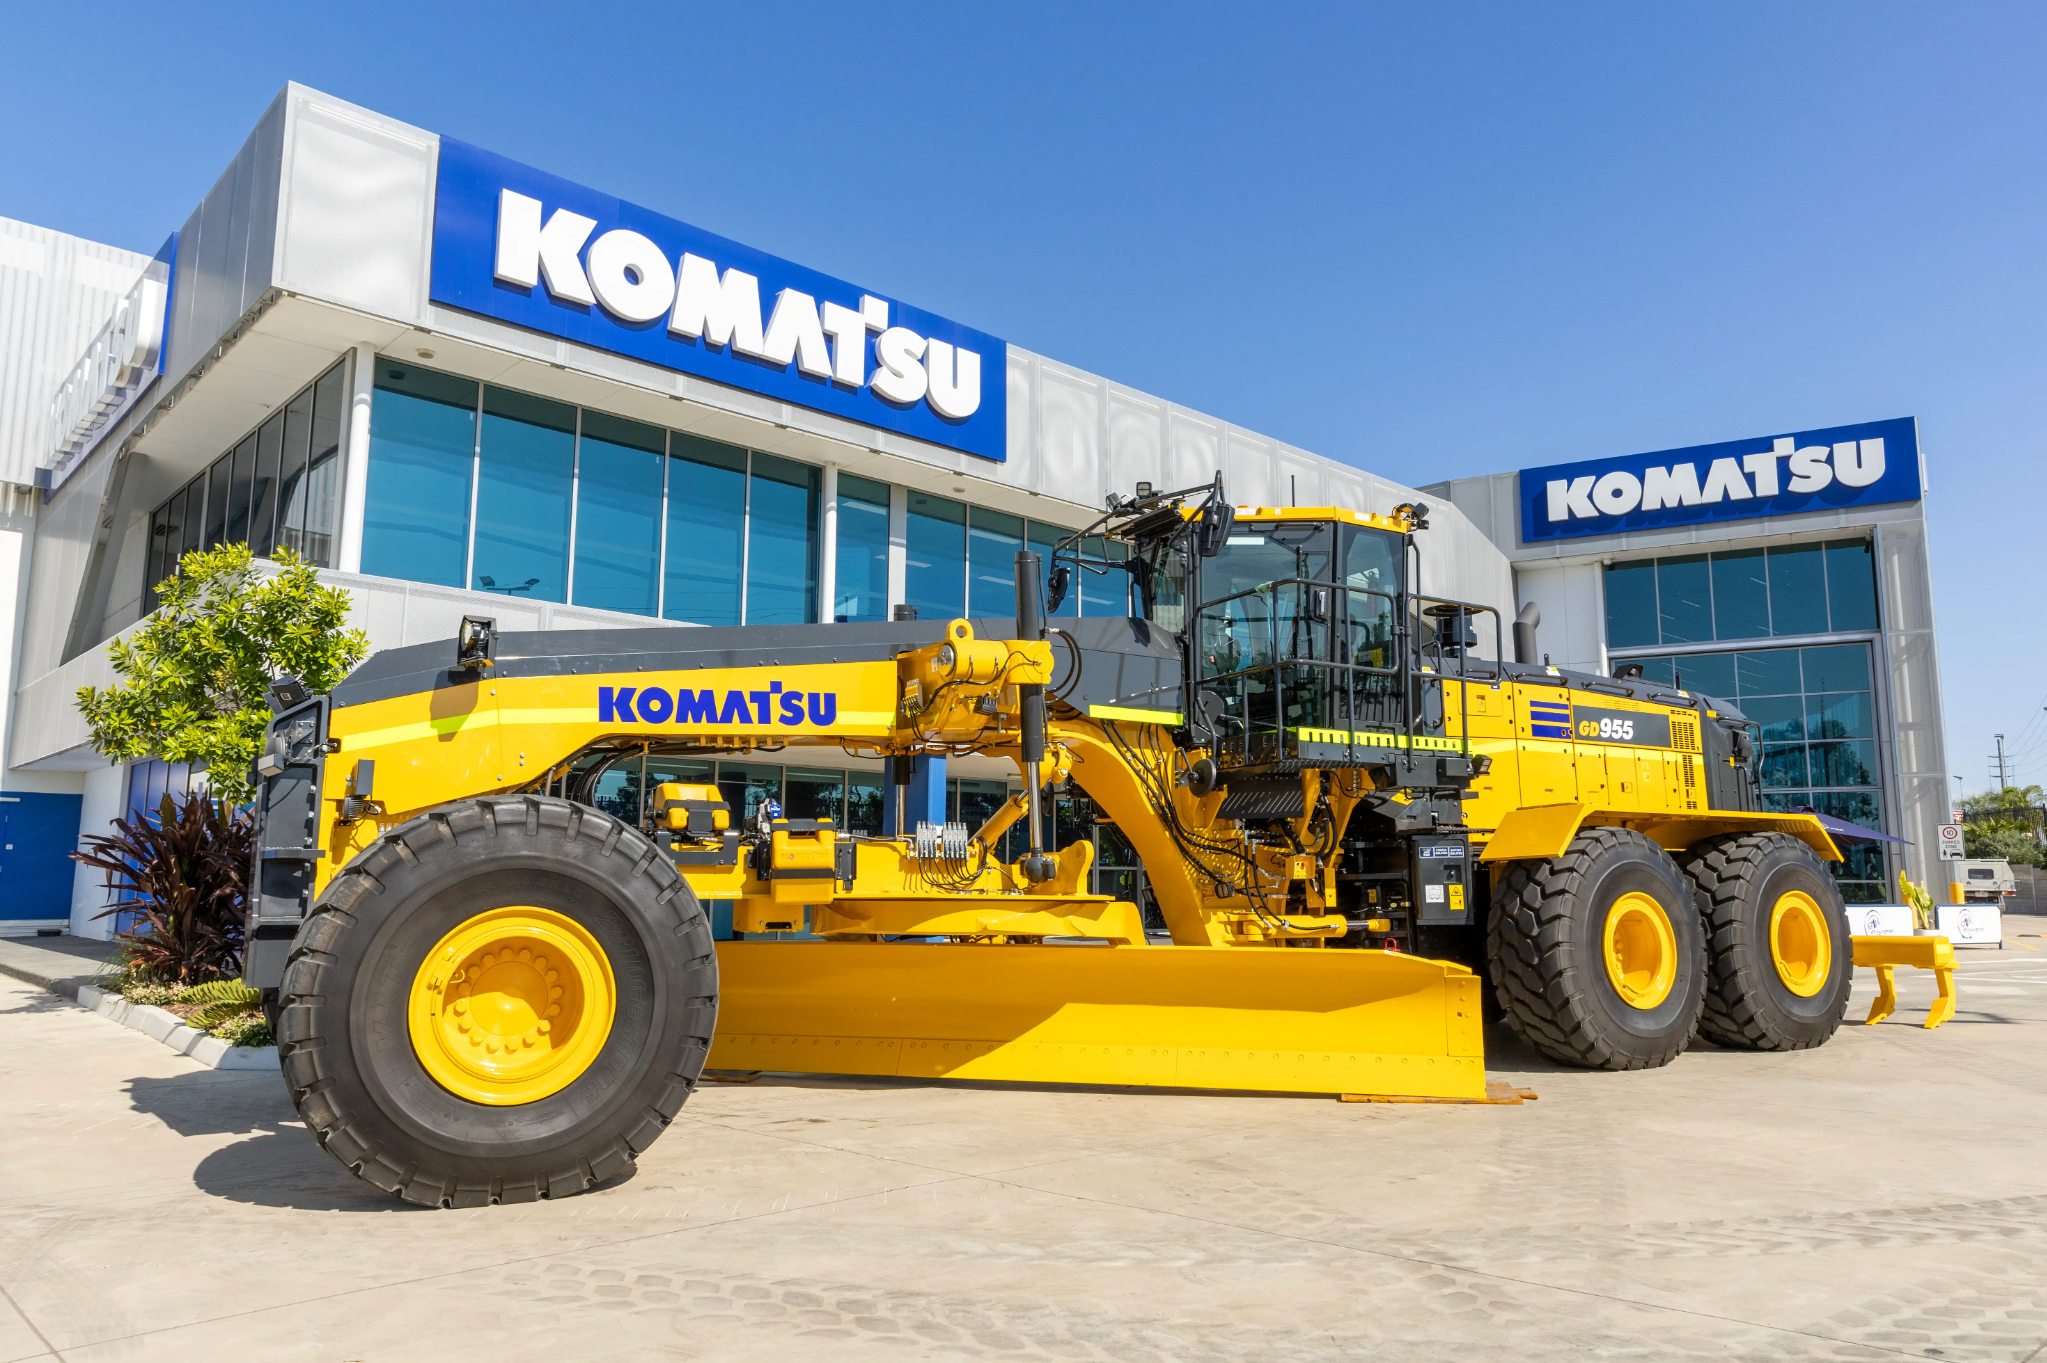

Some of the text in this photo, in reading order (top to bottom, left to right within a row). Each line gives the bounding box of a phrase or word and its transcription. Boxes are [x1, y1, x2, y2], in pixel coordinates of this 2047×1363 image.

[493, 188, 981, 419] KOMATSU
[1547, 437, 1886, 522] KOMATSU
[598, 681, 836, 726] KOMATSU
[1579, 718, 1633, 740] GD955
